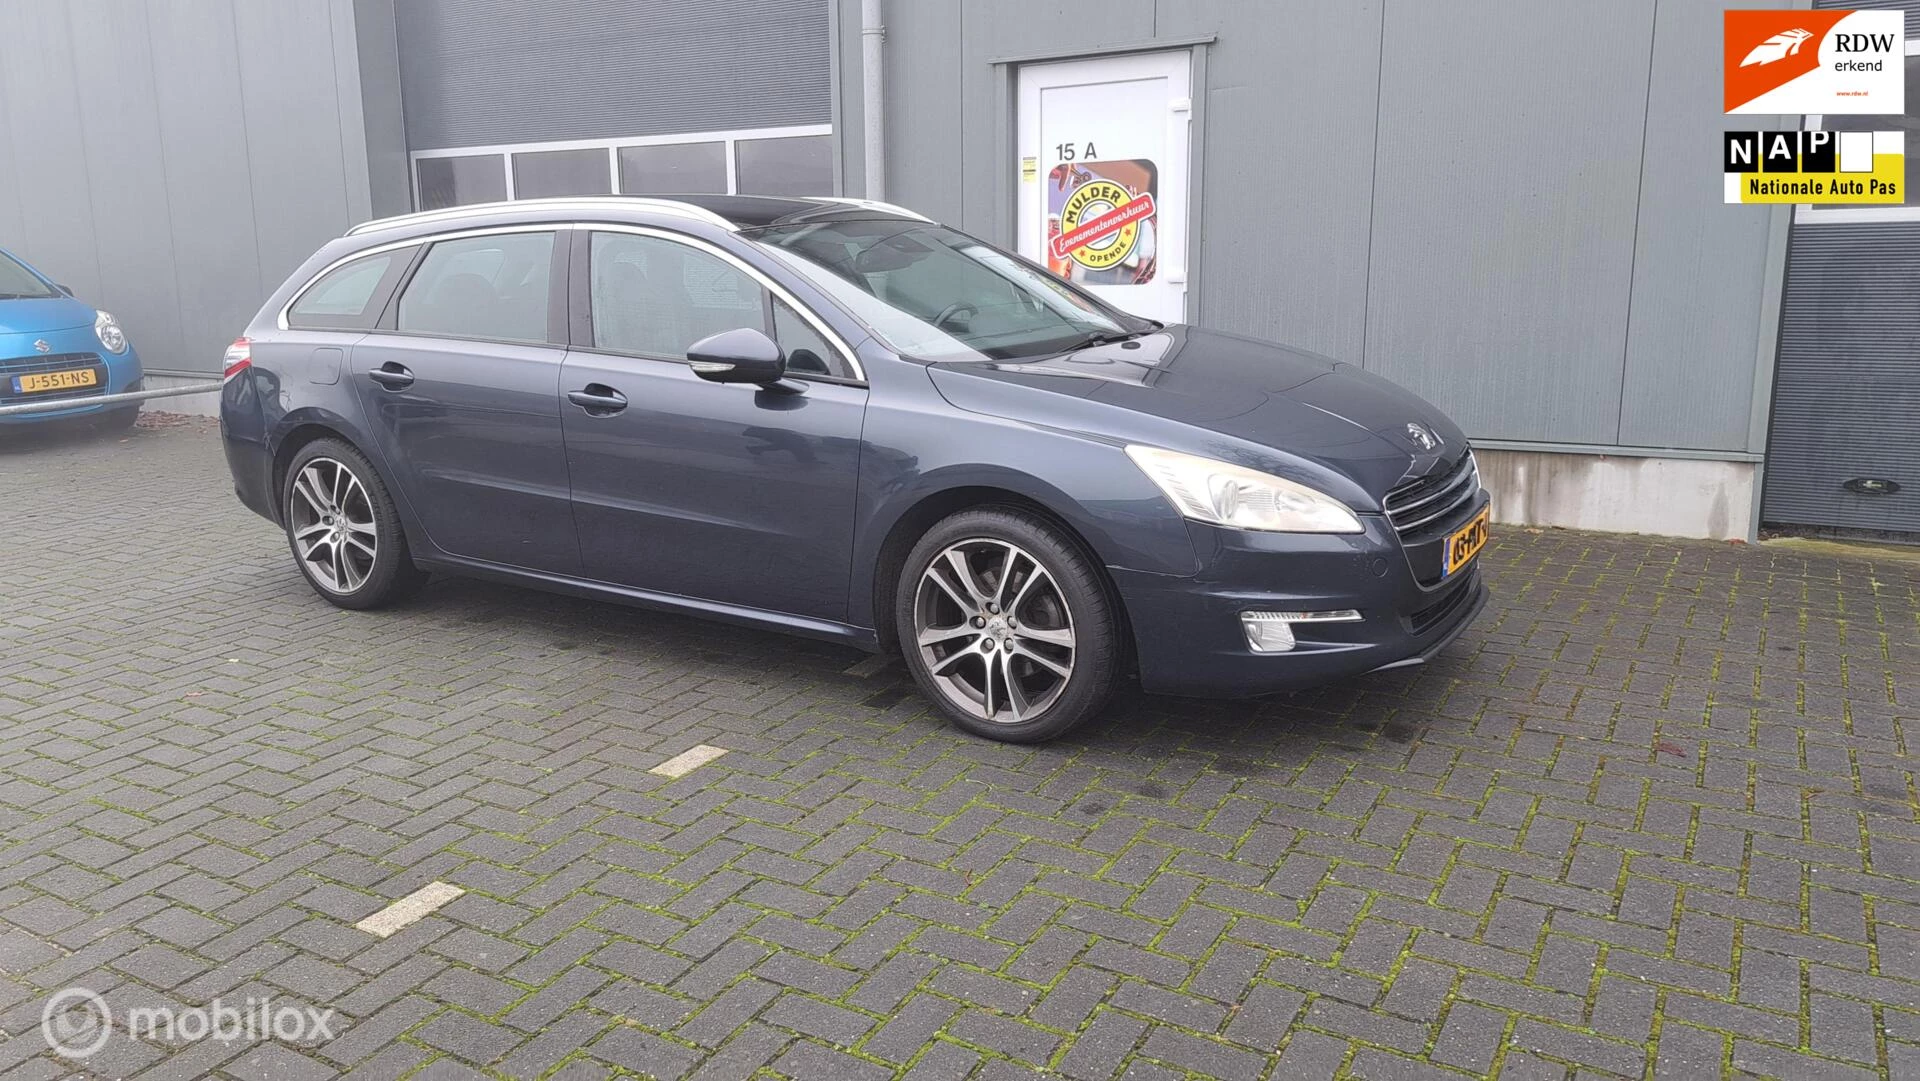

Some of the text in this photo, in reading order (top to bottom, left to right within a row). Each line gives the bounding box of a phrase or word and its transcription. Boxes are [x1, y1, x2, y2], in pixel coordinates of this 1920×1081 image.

[1056, 142, 1098, 161] 15 A
[1066, 186, 1121, 224] MULDER
[1089, 241, 1127, 262] OPENDE
[29, 371, 90, 389] J-551-NS
